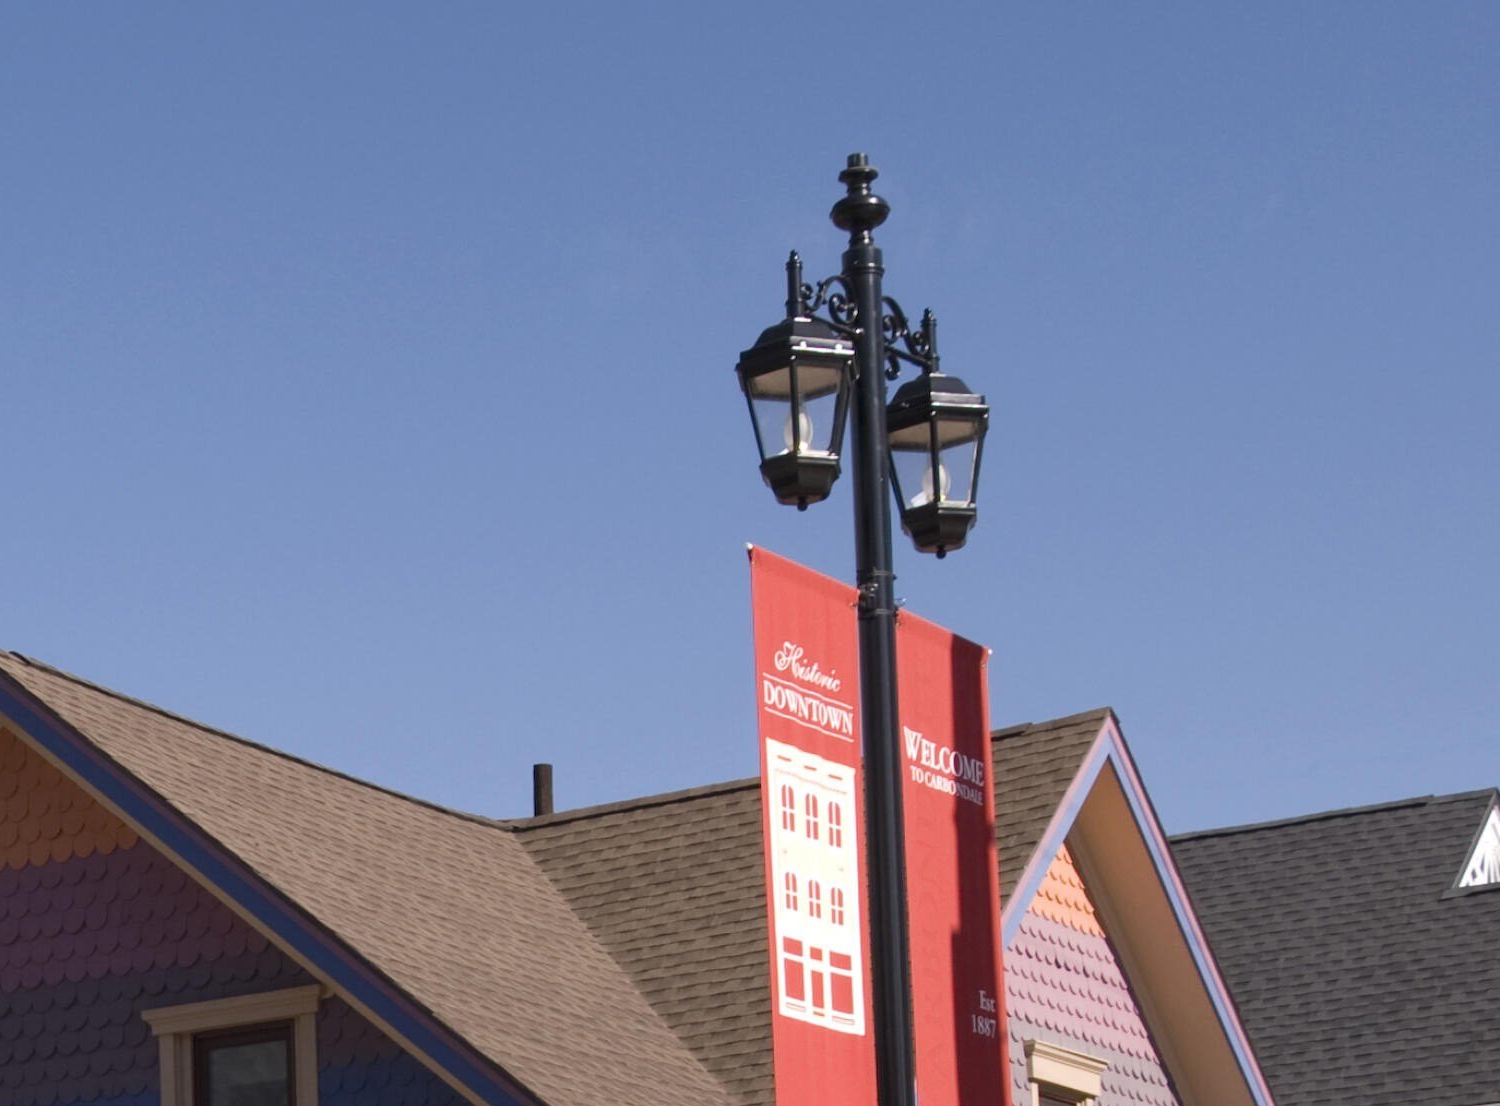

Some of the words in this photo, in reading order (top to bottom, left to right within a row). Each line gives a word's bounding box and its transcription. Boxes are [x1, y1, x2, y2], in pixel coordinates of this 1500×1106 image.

[774, 641, 841, 692] Historic
[763, 680, 853, 735] DOWNTOWN
[903, 726, 984, 787] WELCOME
[910, 765, 925, 784] TO
[925, 772, 984, 806] CARBONDALE
[972, 1014, 997, 1039] 1887
